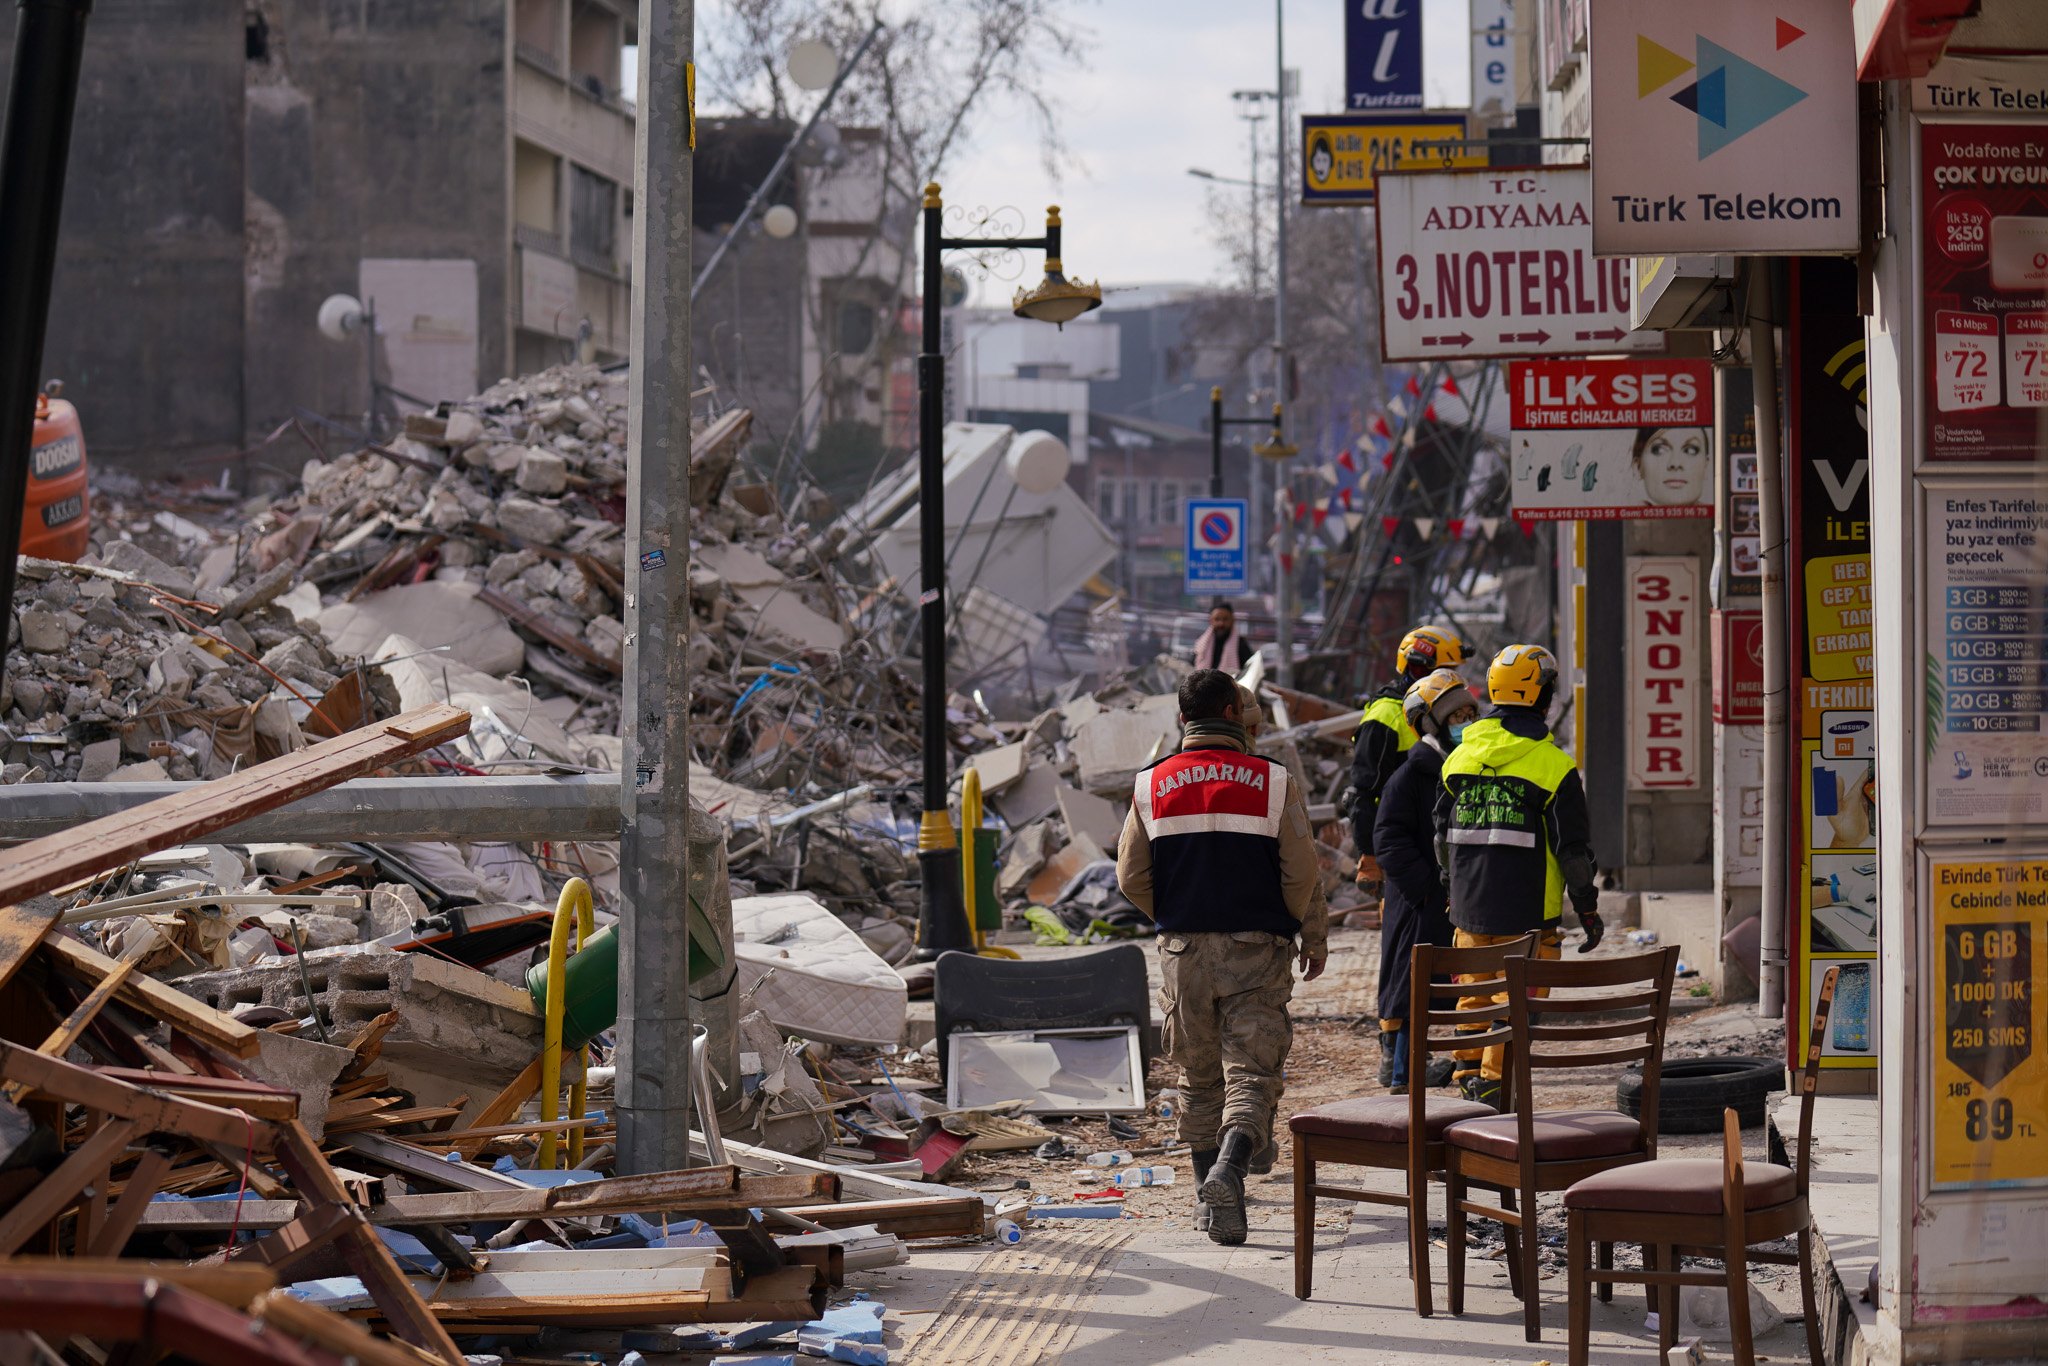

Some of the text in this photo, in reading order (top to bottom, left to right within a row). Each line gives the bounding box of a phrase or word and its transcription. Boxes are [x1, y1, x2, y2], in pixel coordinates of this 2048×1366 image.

[1352, 91, 1424, 107] Turizm
[1927, 85, 1981, 107] Türk
[1943, 143, 2045, 158] Vodafone Ev
[1489, 179, 1547, 194] T.C.
[1933, 166, 1977, 190] ÇOK
[1612, 192, 1841, 222] Türk Telekom
[1422, 202, 1591, 230] ADIYAMA
[1961, 212, 1970, 223] 3
[1971, 214, 1983, 226] ay
[1946, 226, 1984, 241] %50
[1946, 240, 1985, 252] indirim
[1950, 318, 1988, 331] 16 Mbps
[2017, 319, 2028, 329] 24
[1523, 369, 1698, 406] İLK SES
[1525, 406, 1697, 427] İŞİTME CİHAZLARI MERKEZİ
[1946, 499, 1987, 513] Enfes
[1826, 516, 1870, 541] İLE
[1946, 519, 1972, 531] yaz
[1946, 532, 2037, 548] bu yaz enfes
[1946, 549, 2004, 566] geçecek
[1834, 562, 1867, 580] HER
[1823, 586, 1854, 604] CEP
[1950, 589, 1987, 605] 3 GB
[1950, 615, 1989, 631] 6 GB
[1816, 633, 1870, 652] EKRAN
[1950, 641, 1997, 657] 10 GB
[1950, 667, 1995, 683] 15 GB
[1645, 609, 1684, 773] NOTER
[1951, 693, 2000, 709] 20 GB
[1833, 723, 1865, 731] SAMSUNG
[1972, 717, 1988, 730] 10
[1988, 717, 2008, 730] GB
[1155, 763, 1265, 798] JANDARMA
[1455, 805, 1475, 827] Taipei
[1505, 806, 1524, 824] Team
[1941, 868, 1992, 884] Evinde
[1996, 866, 2029, 882] Türk
[1950, 891, 2012, 908] Cebinde
[1960, 929, 2018, 960] 6 GB
[1952, 980, 2025, 1002] 1000 DK
[1952, 1027, 2026, 1048] 250 SMS
[1948, 1082, 1971, 1097] 105
[1965, 1097, 2037, 1142] 89 TL
